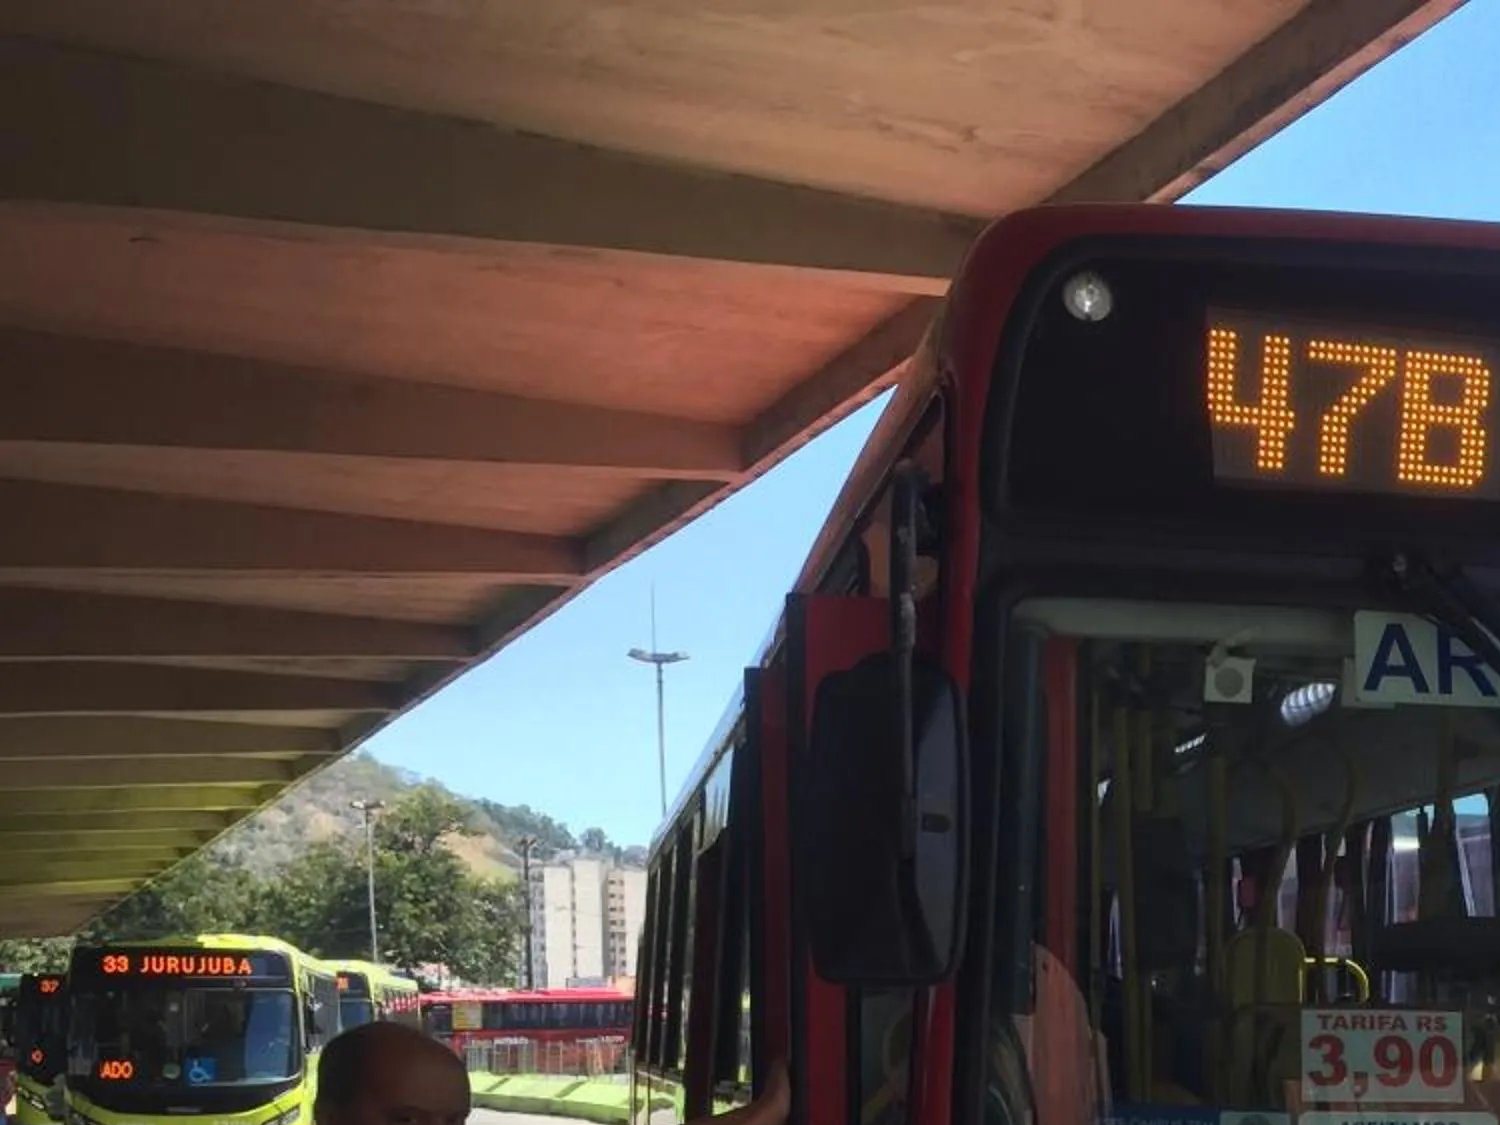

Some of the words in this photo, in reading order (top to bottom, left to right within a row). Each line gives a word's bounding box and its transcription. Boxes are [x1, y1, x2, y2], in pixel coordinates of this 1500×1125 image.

[1205, 326, 1493, 487] 47B
[103, 955, 129, 974] 33
[140, 955, 252, 975] JURUJUBA
[1317, 1014, 1409, 1032] TARIFA
[1308, 1034, 1460, 1098] 3,90
